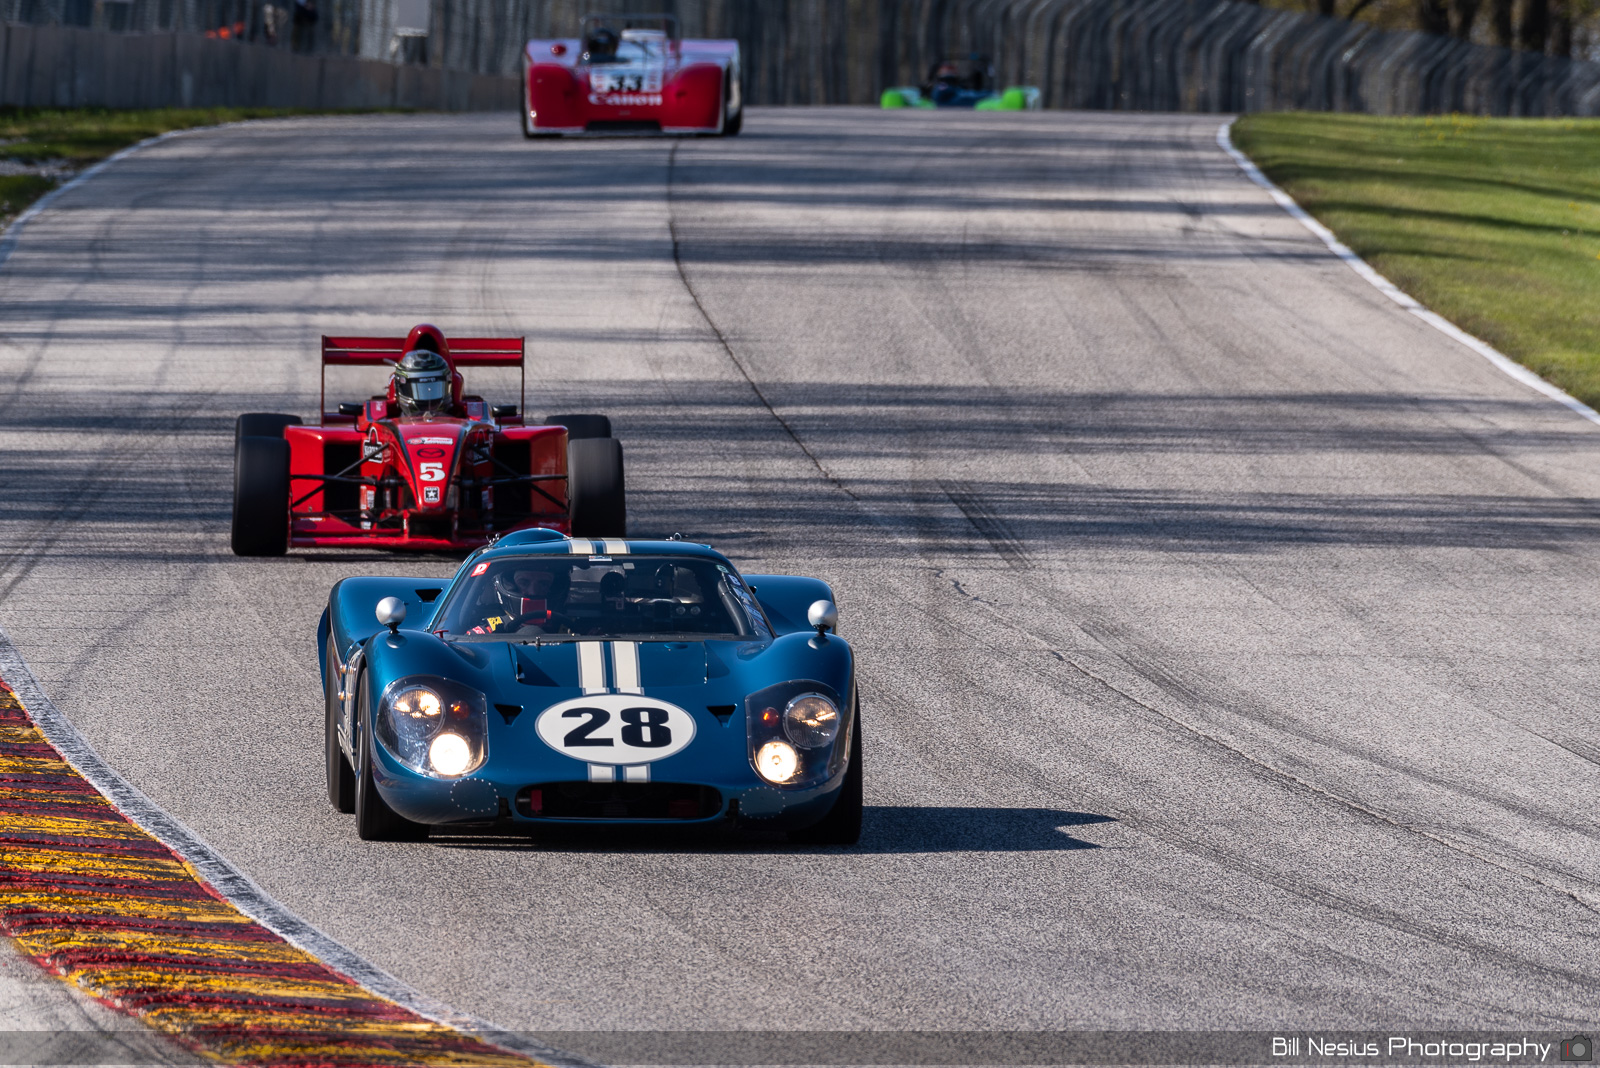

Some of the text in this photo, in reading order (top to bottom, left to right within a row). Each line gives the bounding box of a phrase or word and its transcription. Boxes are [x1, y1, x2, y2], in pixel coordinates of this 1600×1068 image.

[609, 74, 643, 91] 33
[588, 93, 663, 106] Canon
[419, 462, 446, 482] 5
[561, 707, 672, 748] 28
